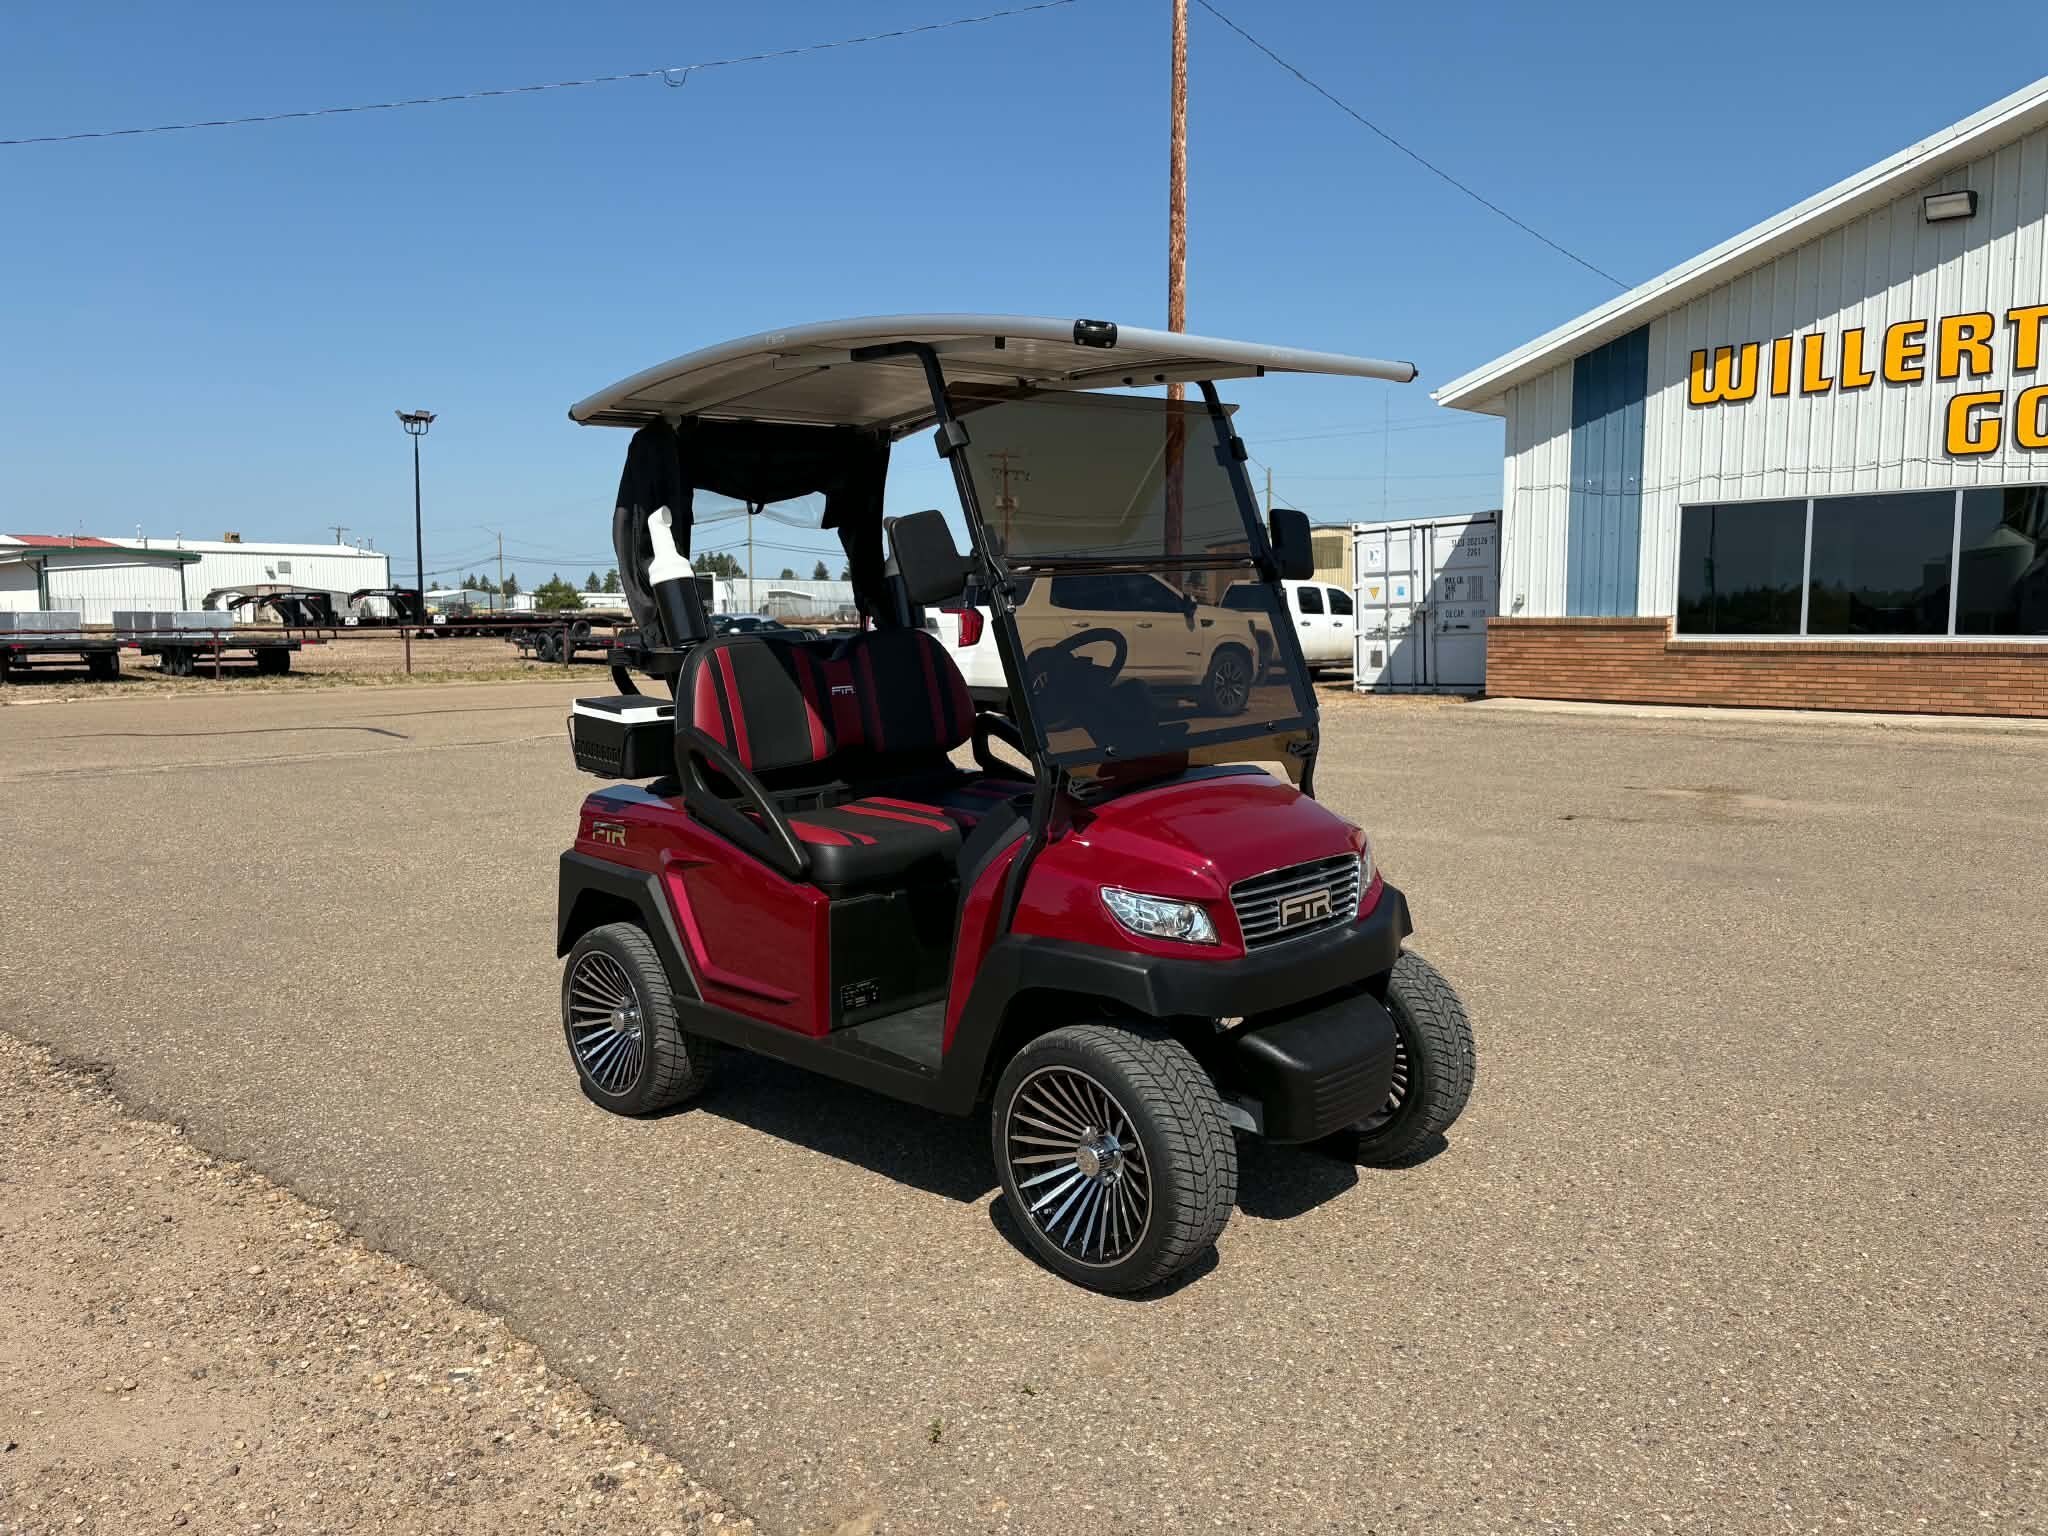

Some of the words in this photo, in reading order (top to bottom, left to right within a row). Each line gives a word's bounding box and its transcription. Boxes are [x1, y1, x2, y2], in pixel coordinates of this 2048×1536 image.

[1688, 304, 2048, 406] WILLERT
[592, 821, 626, 847] FTR
[1281, 888, 1332, 926] FTR
